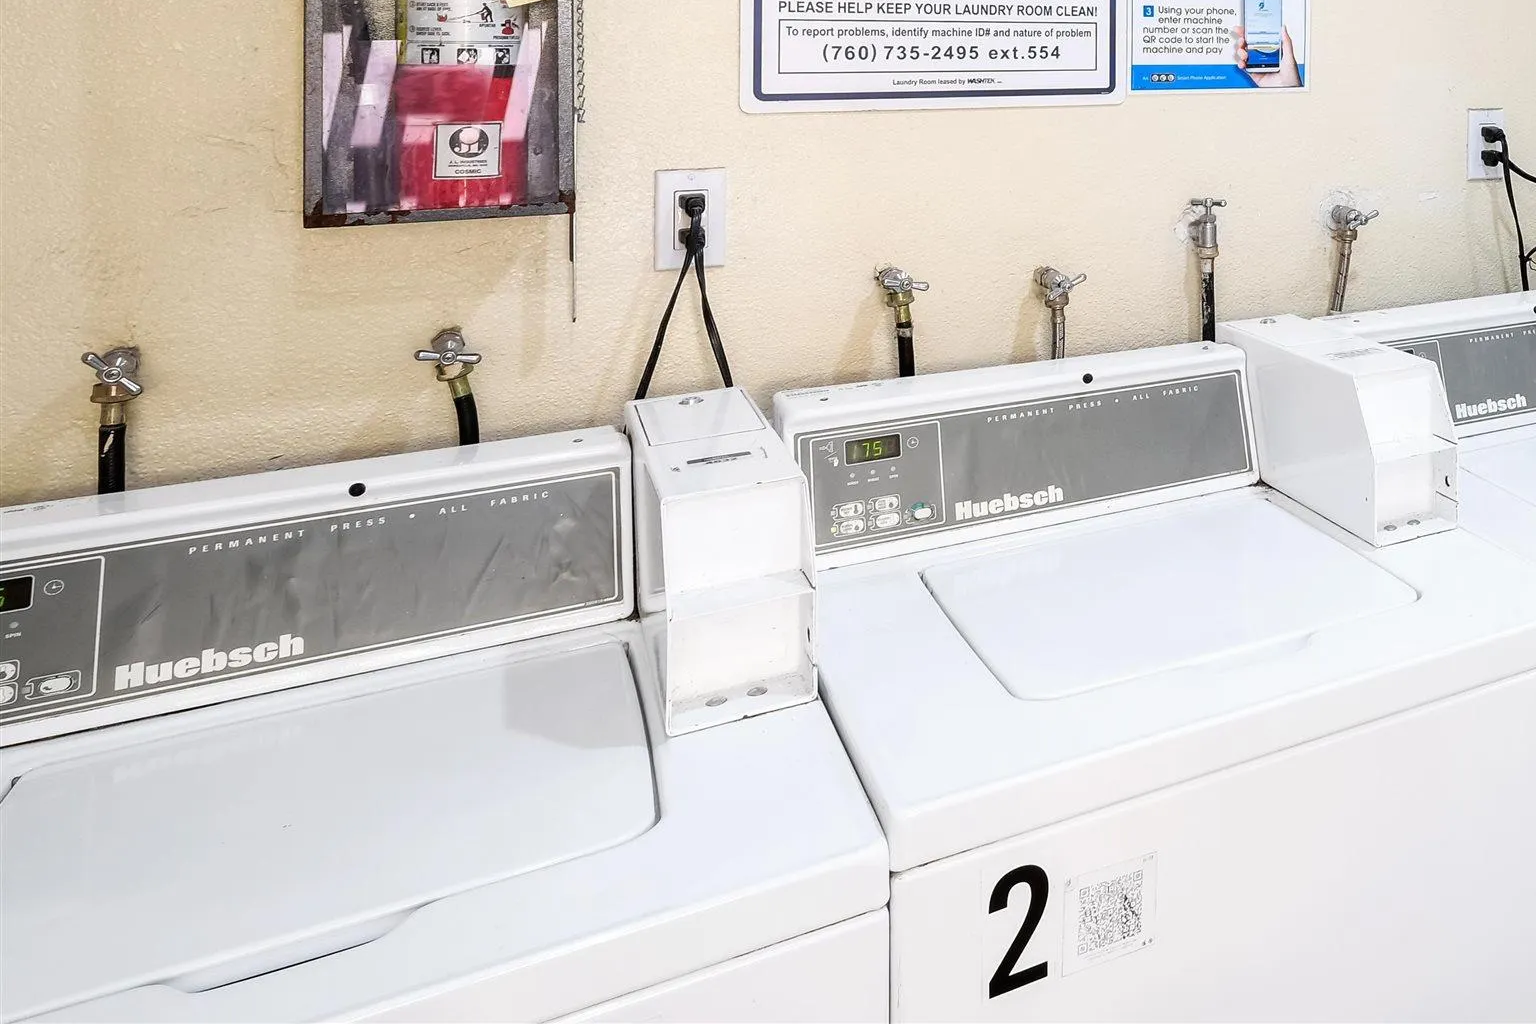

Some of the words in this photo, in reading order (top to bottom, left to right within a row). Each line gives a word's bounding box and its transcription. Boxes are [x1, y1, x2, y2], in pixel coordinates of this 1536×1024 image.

[779, 1, 833, 13] PLEASE
[838, 2, 872, 13] HELP
[877, 3, 911, 14] KEEP
[916, 4, 951, 15] YOUR
[956, 5, 1013, 15] LAUNDRY
[1017, 5, 1052, 16] ROOM
[1056, 6, 1097, 16] CLEAN!
[1145, 7, 1152, 16] 3
[1159, 6, 1182, 16] Using
[1185, 8, 1204, 16] your
[1206, 6, 1236, 16] phone,
[786, 26, 798, 36] To
[802, 27, 833, 38] report
[838, 27, 888, 38] problems,
[892, 27, 928, 38] identify
[932, 28, 972, 37] machine
[976, 28, 990, 36] ID#
[994, 29, 1010, 37] and
[1045, 29, 1053, 37] of
[1056, 29, 1091, 38] problem
[1143, 36, 1156, 44] QR
[1159, 36, 1182, 44] code
[1196, 36, 1214, 44] start
[1216, 36, 1230, 44] the
[823, 44, 877, 62] (760)
[884, 46, 979, 60] 735-2495
[989, 46, 1060, 59] ext.554
[1143, 46, 1183, 54] machine
[1186, 46, 1203, 54] and
[1206, 46, 1223, 55] pay
[1470, 332, 1514, 343] PERMANENT
[987, 408, 1054, 423] PERMANENT
[1069, 401, 1101, 410] PRESS
[1163, 386, 1199, 396] FABRIC
[1455, 394, 1527, 419] Huebsch
[955, 485, 1063, 521] Huebsch
[189, 530, 304, 554] PERMANENT
[330, 517, 386, 532] PRESS
[439, 505, 467, 515] ALL
[491, 491, 549, 506] FABRIC
[114, 634, 304, 691] Huebsch
[989, 864, 1049, 999] 2
